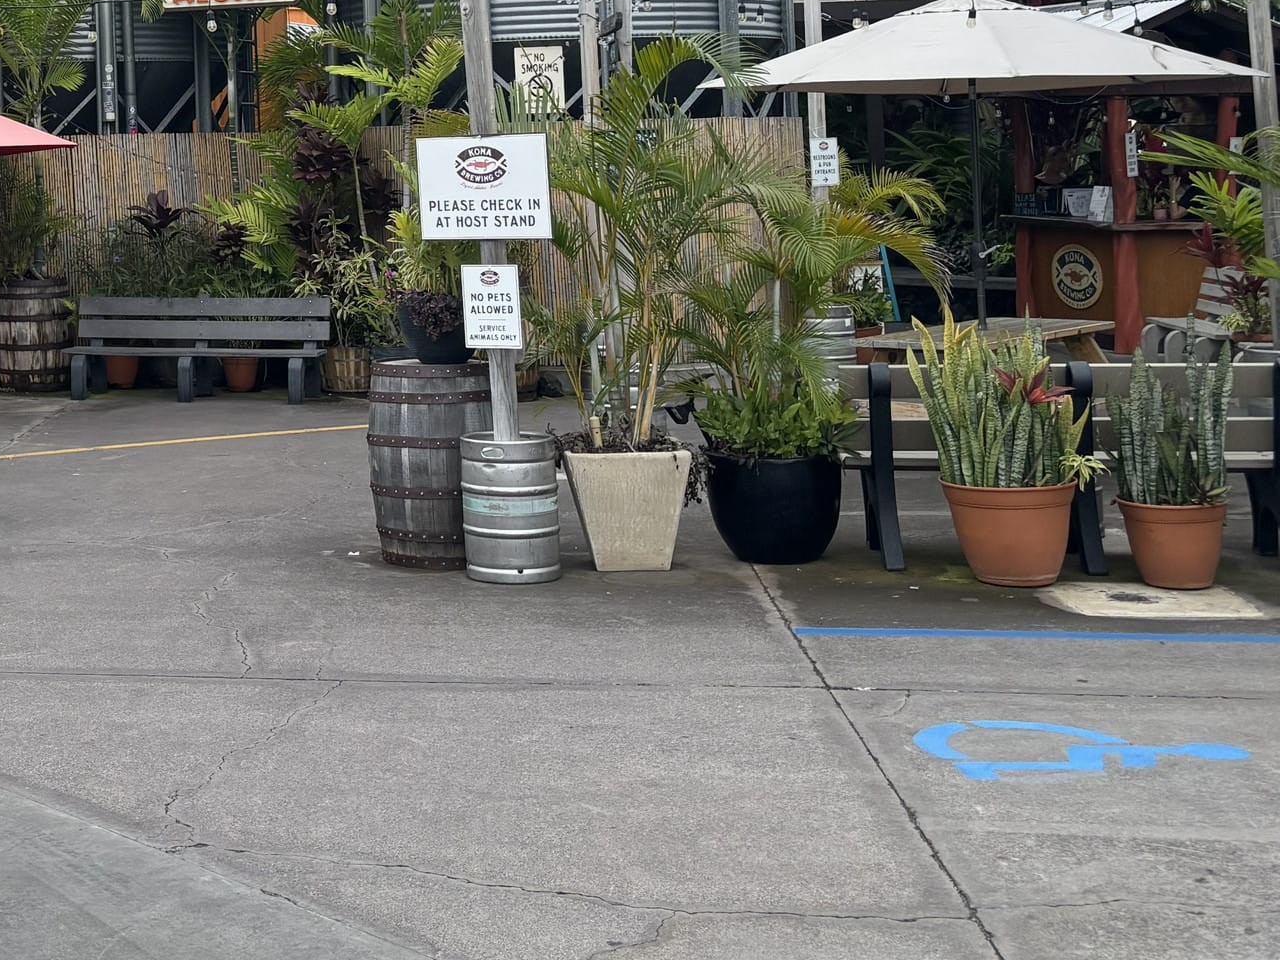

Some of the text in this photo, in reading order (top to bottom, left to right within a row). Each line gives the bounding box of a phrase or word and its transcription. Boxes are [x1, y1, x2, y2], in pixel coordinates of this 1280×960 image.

[533, 53, 545, 62] NO
[521, 62, 559, 74] SMOKING
[468, 147, 492, 157] KONA
[460, 168, 494, 183] BREWING
[429, 198, 541, 212] PLEASE CHECK IN
[436, 215, 536, 228] AT HOST STAND
[1064, 252, 1085, 265] KONA
[470, 292, 512, 302] NO PETS
[470, 305, 514, 315] ALLOWED
